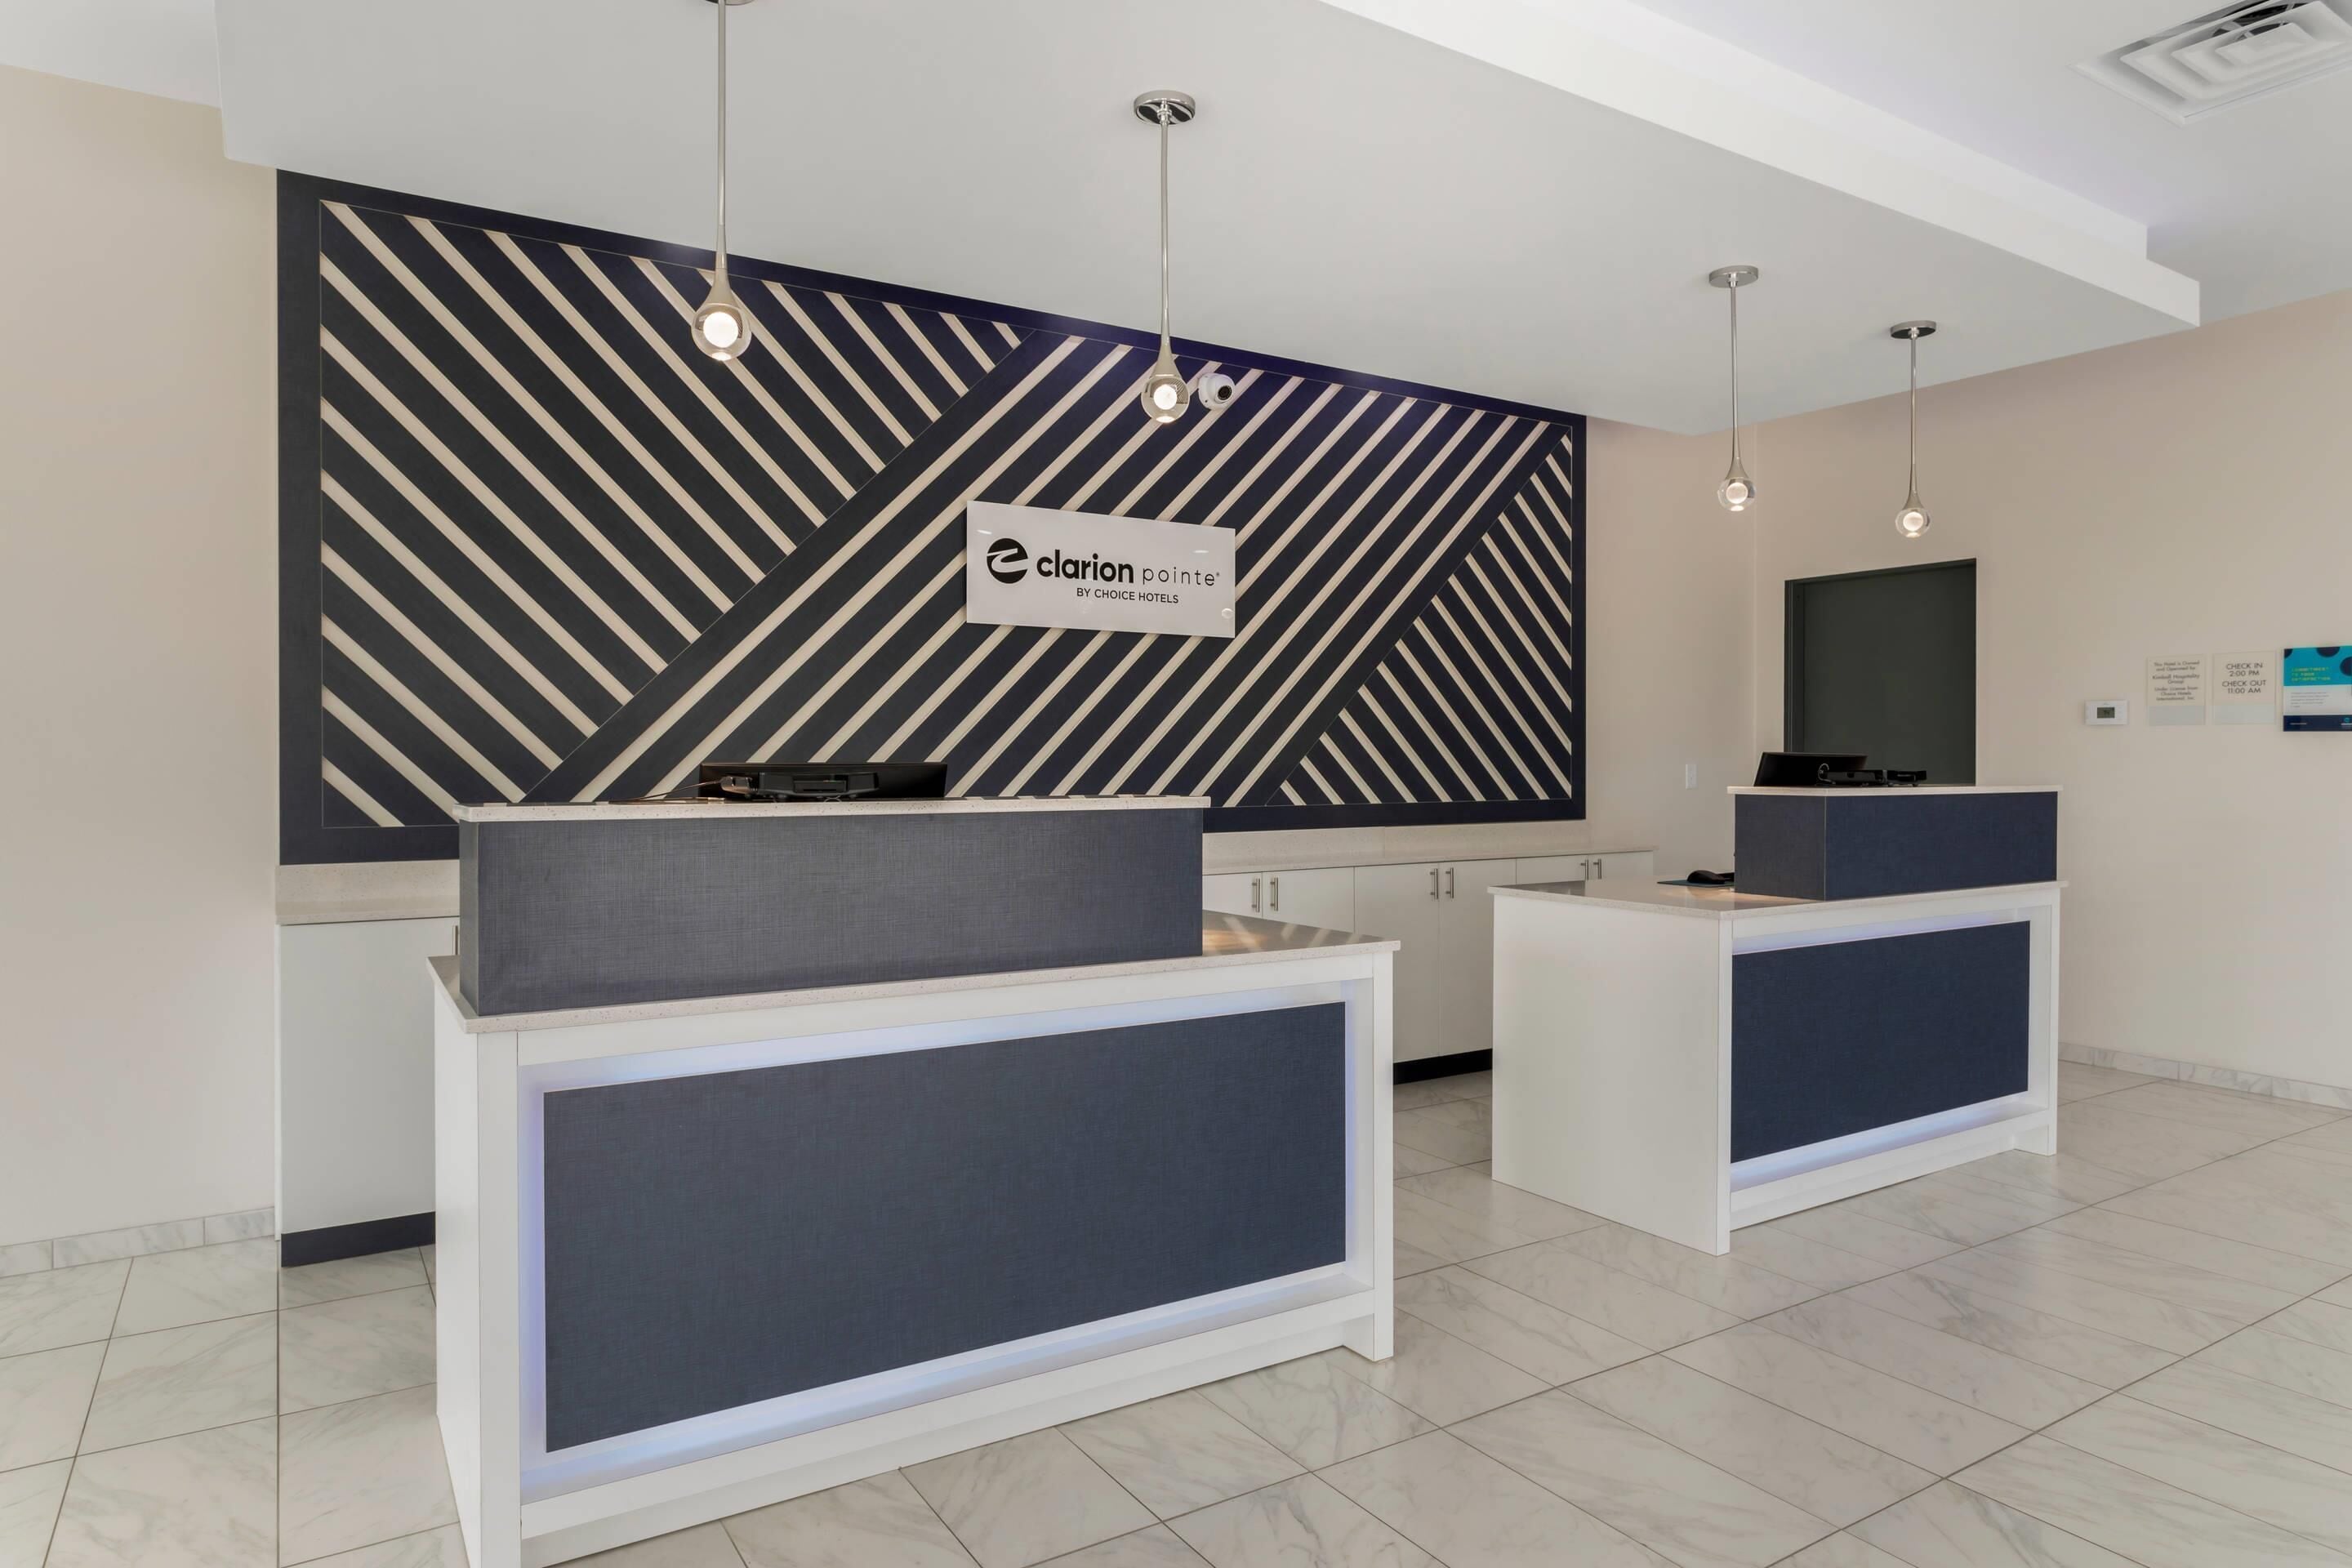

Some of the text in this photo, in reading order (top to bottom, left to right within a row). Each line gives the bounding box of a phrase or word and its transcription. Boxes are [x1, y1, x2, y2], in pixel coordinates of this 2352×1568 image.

[1037, 549, 1134, 583] clarion
[1076, 587, 1179, 604] BY CHOICE HOTELS
